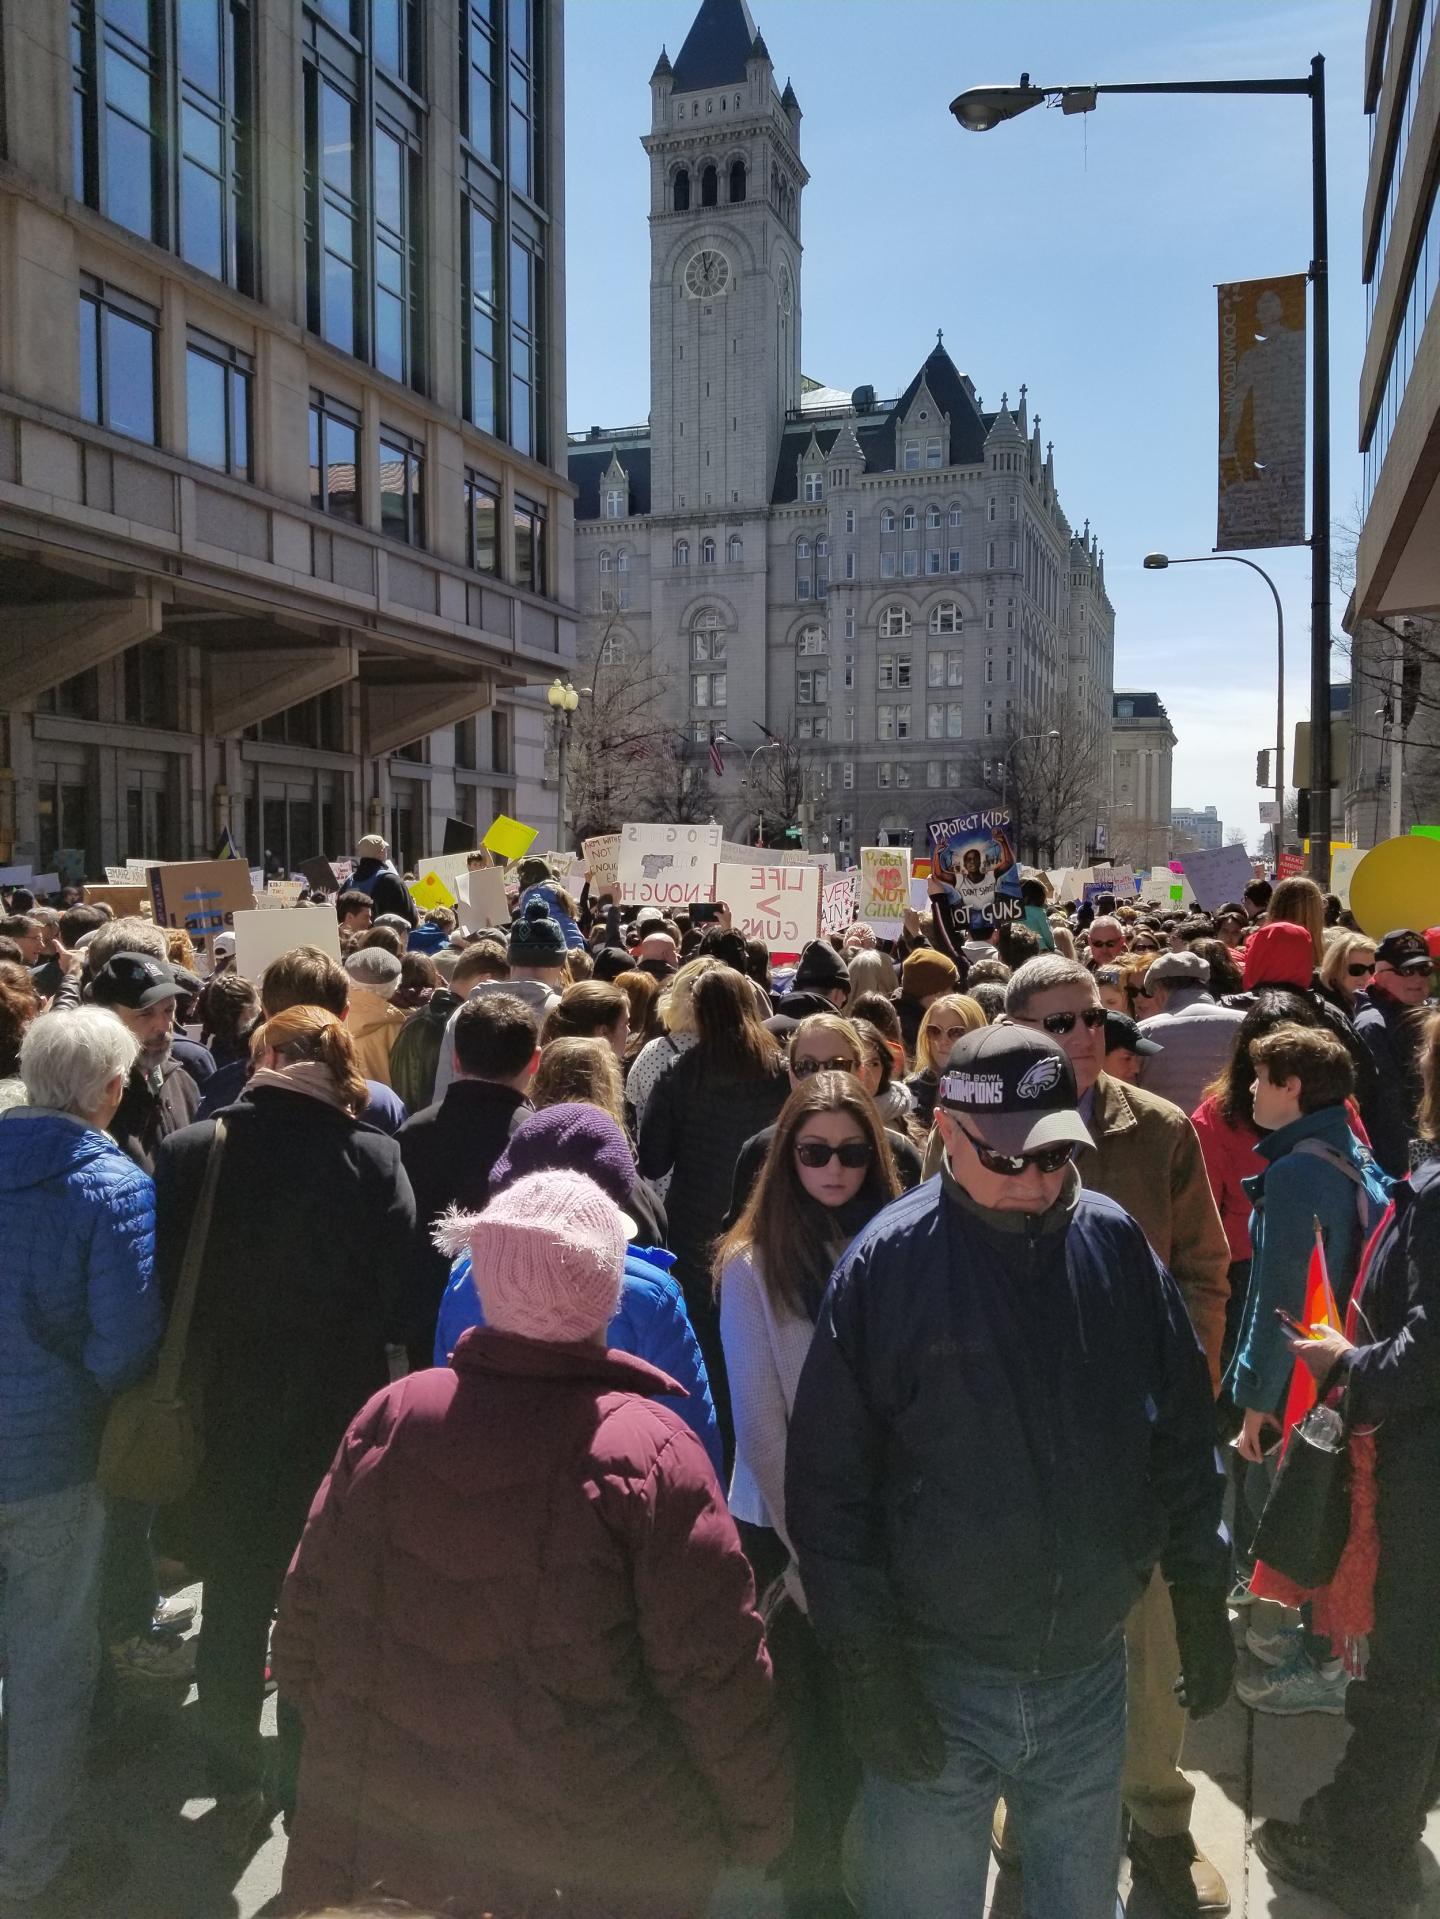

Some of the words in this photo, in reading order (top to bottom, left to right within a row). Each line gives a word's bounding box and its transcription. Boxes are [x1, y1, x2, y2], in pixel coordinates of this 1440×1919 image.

[1223, 313, 1237, 412] DOWNTOWN
[981, 810, 1010, 829] KIDS
[592, 848, 611, 860] NOT
[822, 881, 850, 903] VER
[872, 887, 906, 903] NOT
[822, 901, 843, 924] AIN
[982, 899, 1022, 924] GUNS
[949, 1070, 971, 1081] SUPER
[974, 1074, 1004, 1082] BOWL
[945, 1079, 1004, 1104] CHAMPIONS
